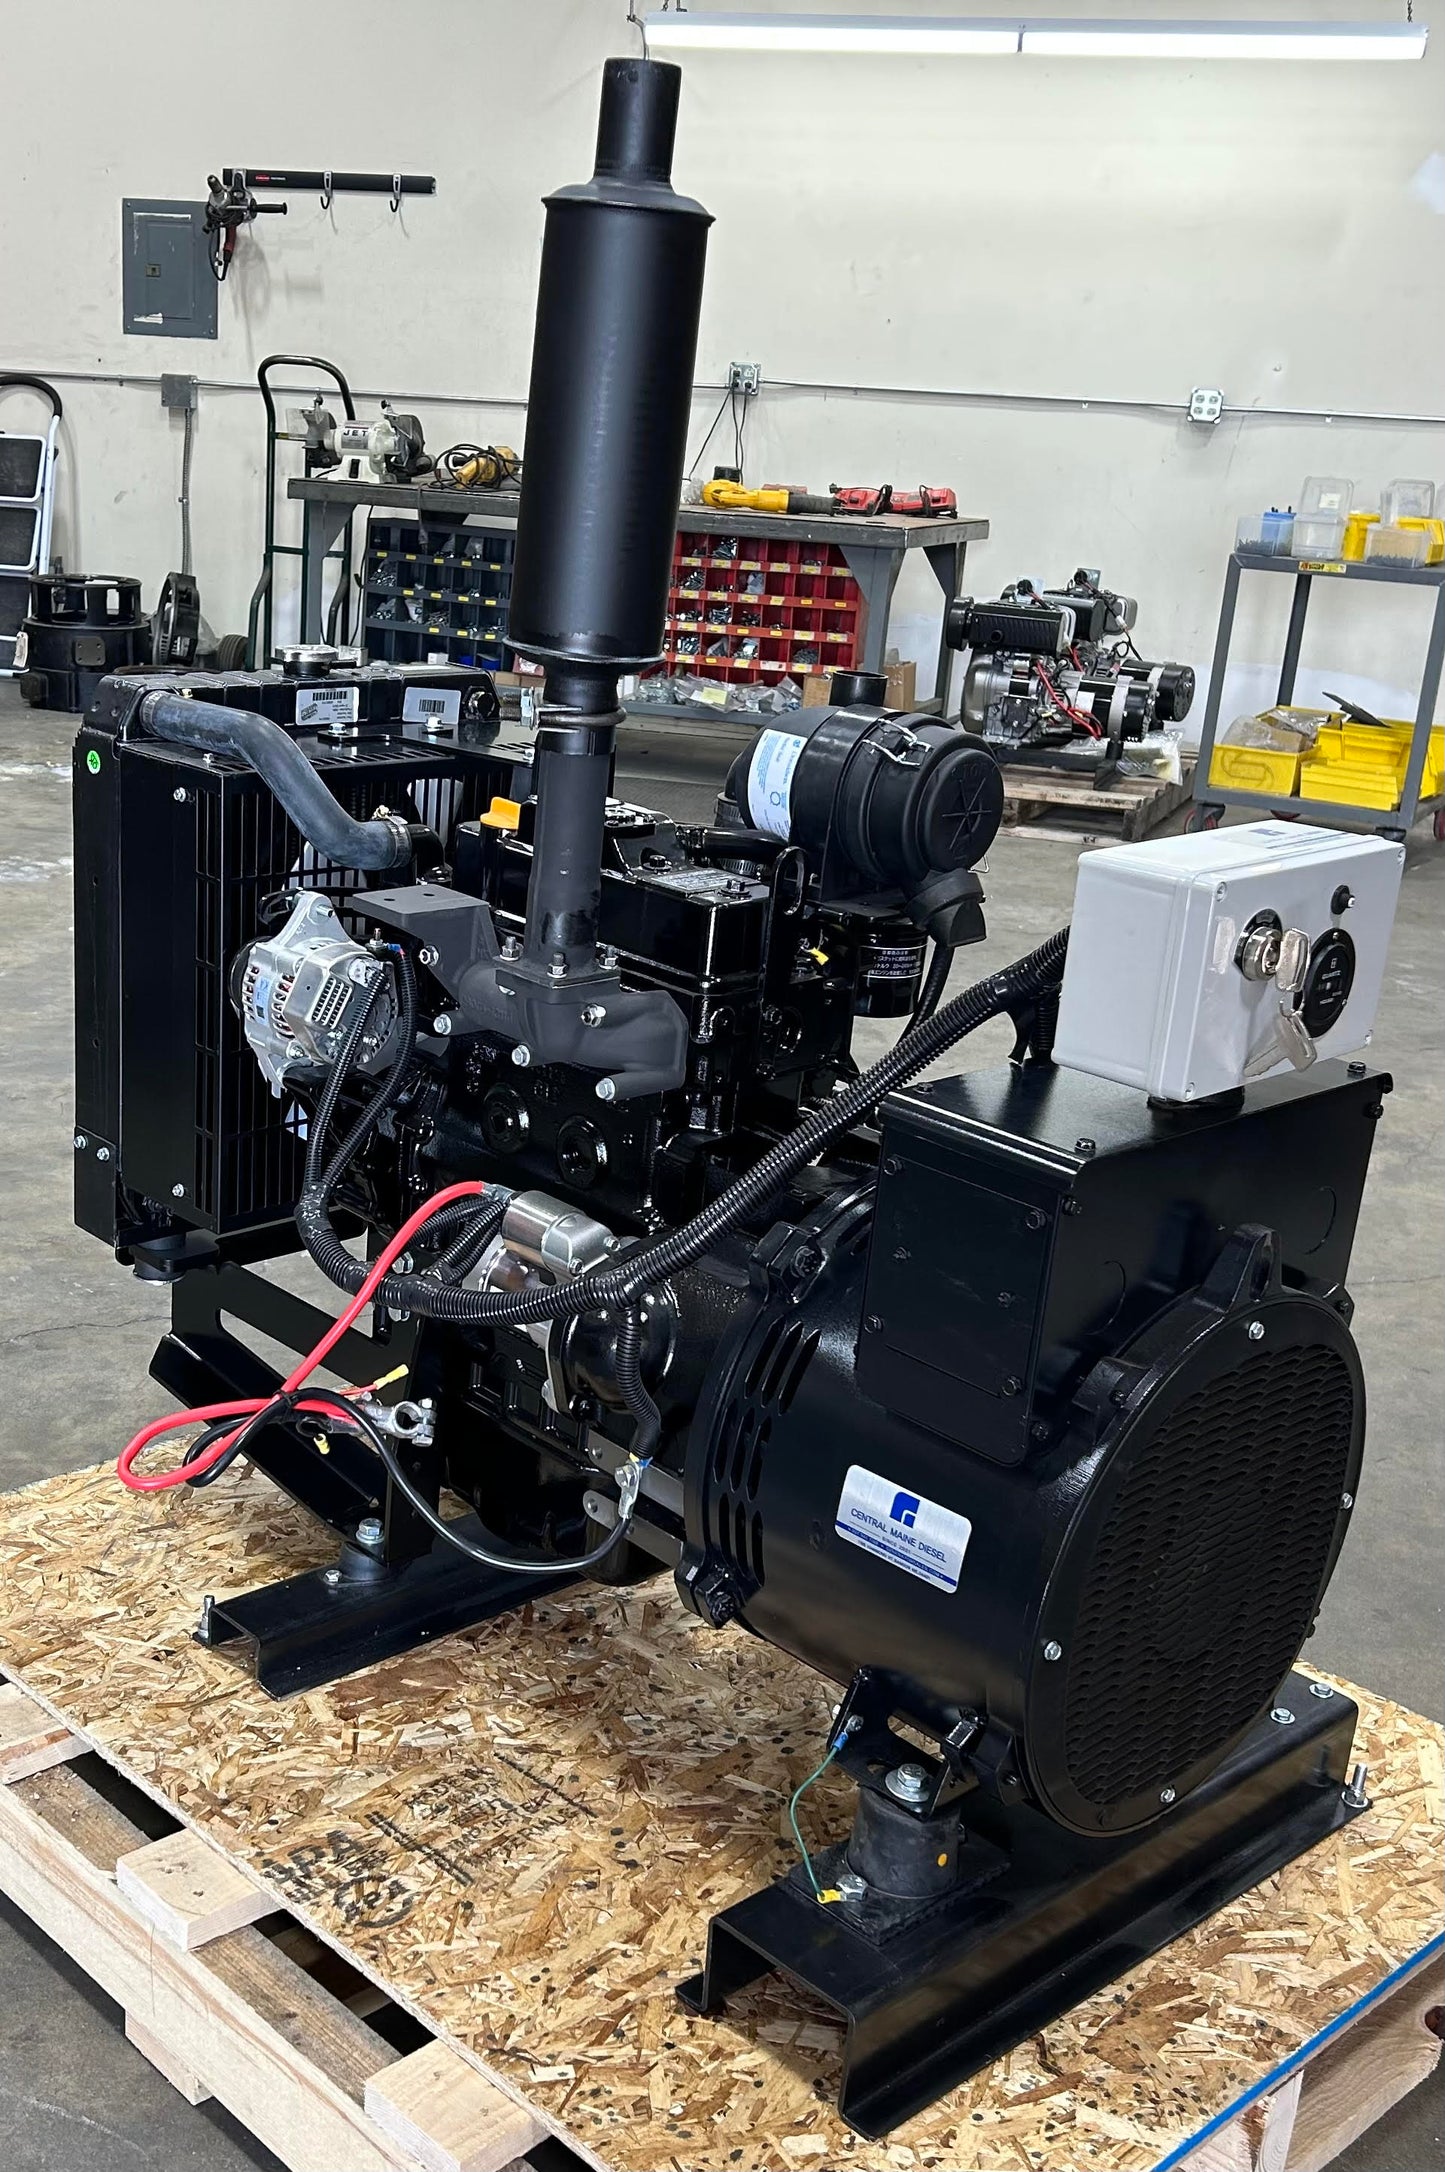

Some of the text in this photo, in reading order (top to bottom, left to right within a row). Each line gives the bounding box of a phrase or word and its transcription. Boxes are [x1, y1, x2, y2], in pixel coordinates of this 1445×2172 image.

[343, 429, 368, 437] JET
[850, 1508, 888, 1533] CENTRAL
[889, 1527, 917, 1547] MAINE
[918, 1541, 946, 1563] DIESEL
